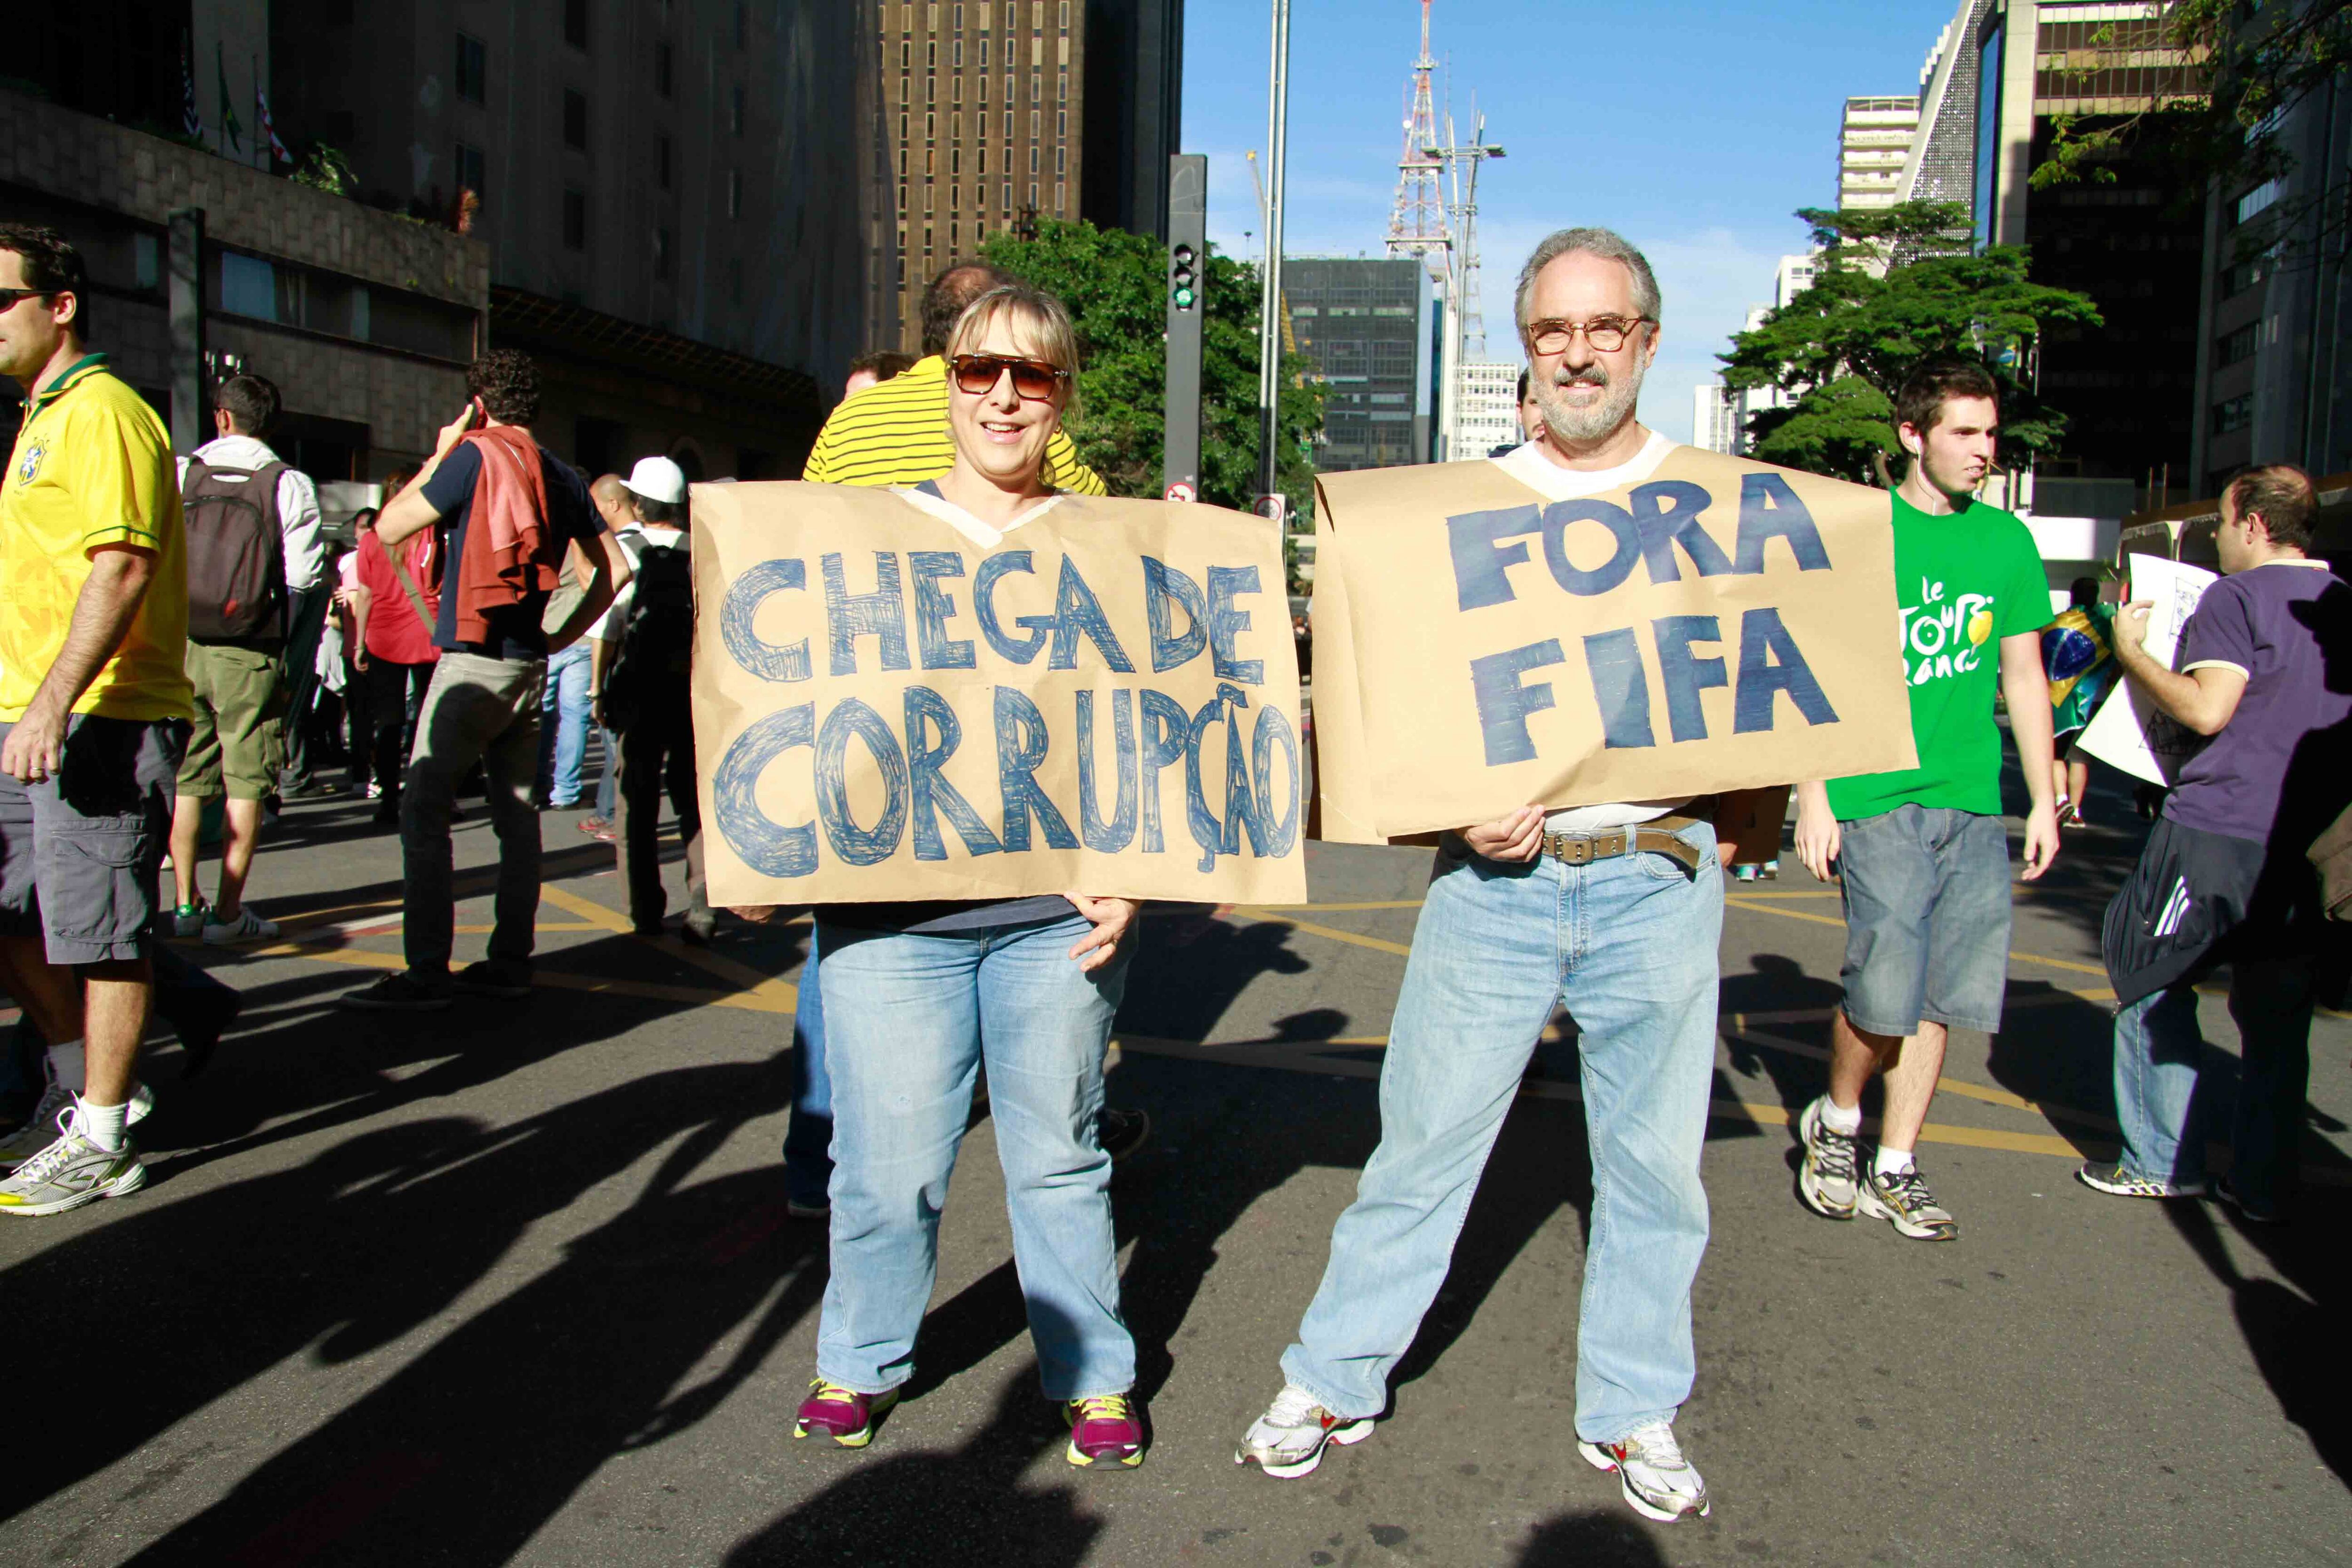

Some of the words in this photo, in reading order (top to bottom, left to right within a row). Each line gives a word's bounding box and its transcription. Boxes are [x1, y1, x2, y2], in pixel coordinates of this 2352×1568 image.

[720, 550, 1135, 682] CHEGA
[1140, 555, 1264, 684] DE
[1446, 473, 1831, 612] FORA
[1470, 607, 1839, 766] FIFA
[714, 683, 1298, 877] CORRUPÇÃO
